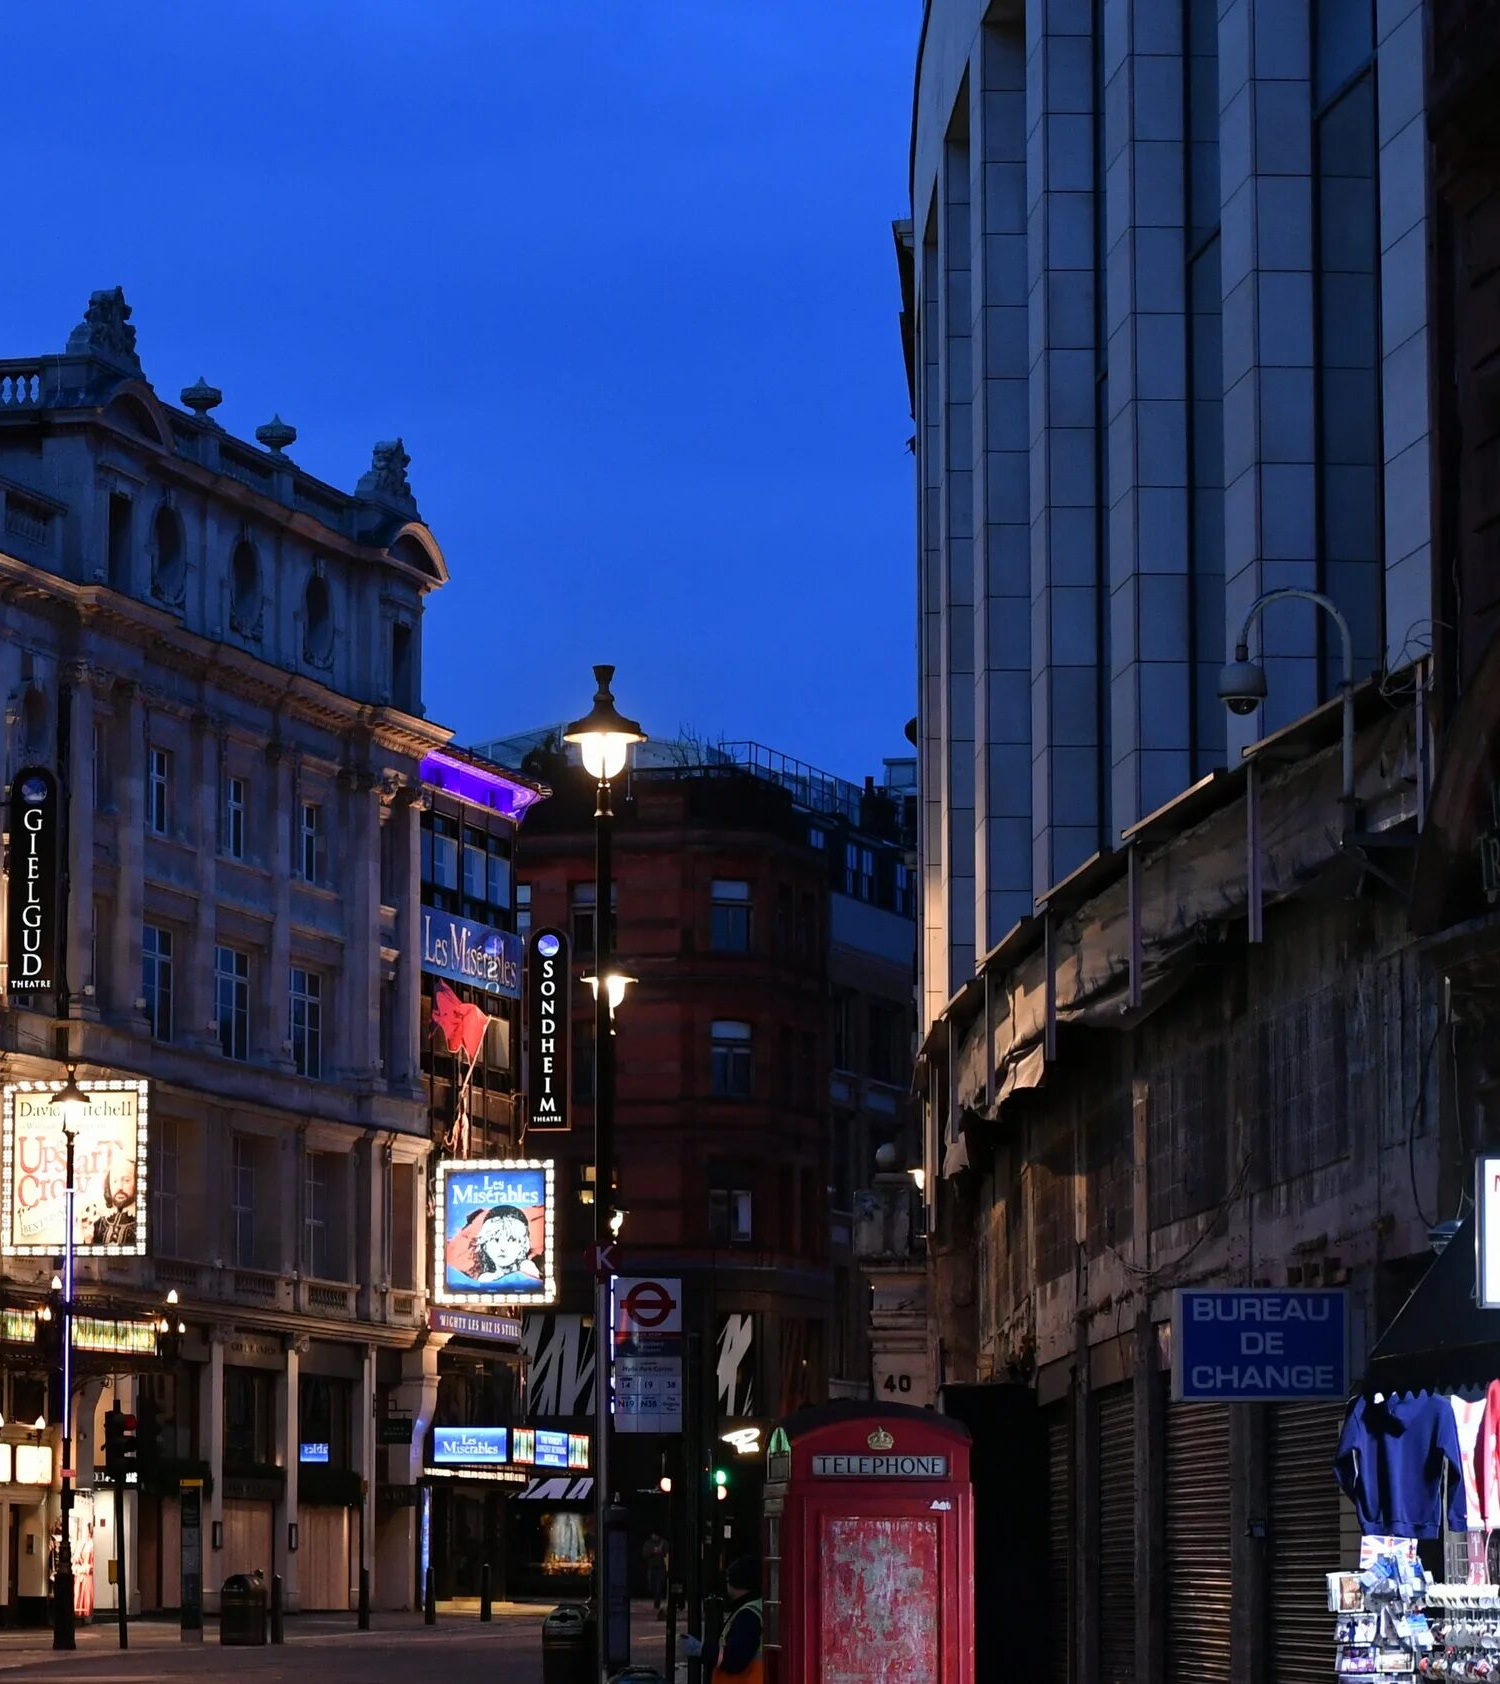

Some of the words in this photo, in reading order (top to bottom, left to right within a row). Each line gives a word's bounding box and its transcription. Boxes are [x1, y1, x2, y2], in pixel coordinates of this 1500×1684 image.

[22, 808, 44, 976] GIELGUD
[425, 915, 448, 967] Les
[11, 980, 51, 989] THEATRE
[539, 960, 556, 1112] SONDHEIM
[83, 1101, 131, 1117] itchell
[533, 1115, 562, 1123] THEATRE
[484, 1176, 504, 1191] Les
[452, 1184, 539, 1205] Misérables
[596, 1246, 615, 1270] K
[1193, 1298, 1329, 1321] BUREAU
[468, 1319, 479, 1331] LES
[481, 1321, 492, 1332] MIZ
[494, 1323, 500, 1334] IS
[501, 1324, 518, 1337] STILL
[1240, 1332, 1284, 1355] DE
[644, 1381, 653, 1389] 19
[883, 1374, 912, 1393] 40
[1192, 1366, 1335, 1389] CHANGE
[443, 1440, 499, 1455] Misérables
[462, 1434, 476, 1446] Les
[817, 1456, 942, 1475] TELEPHONE
